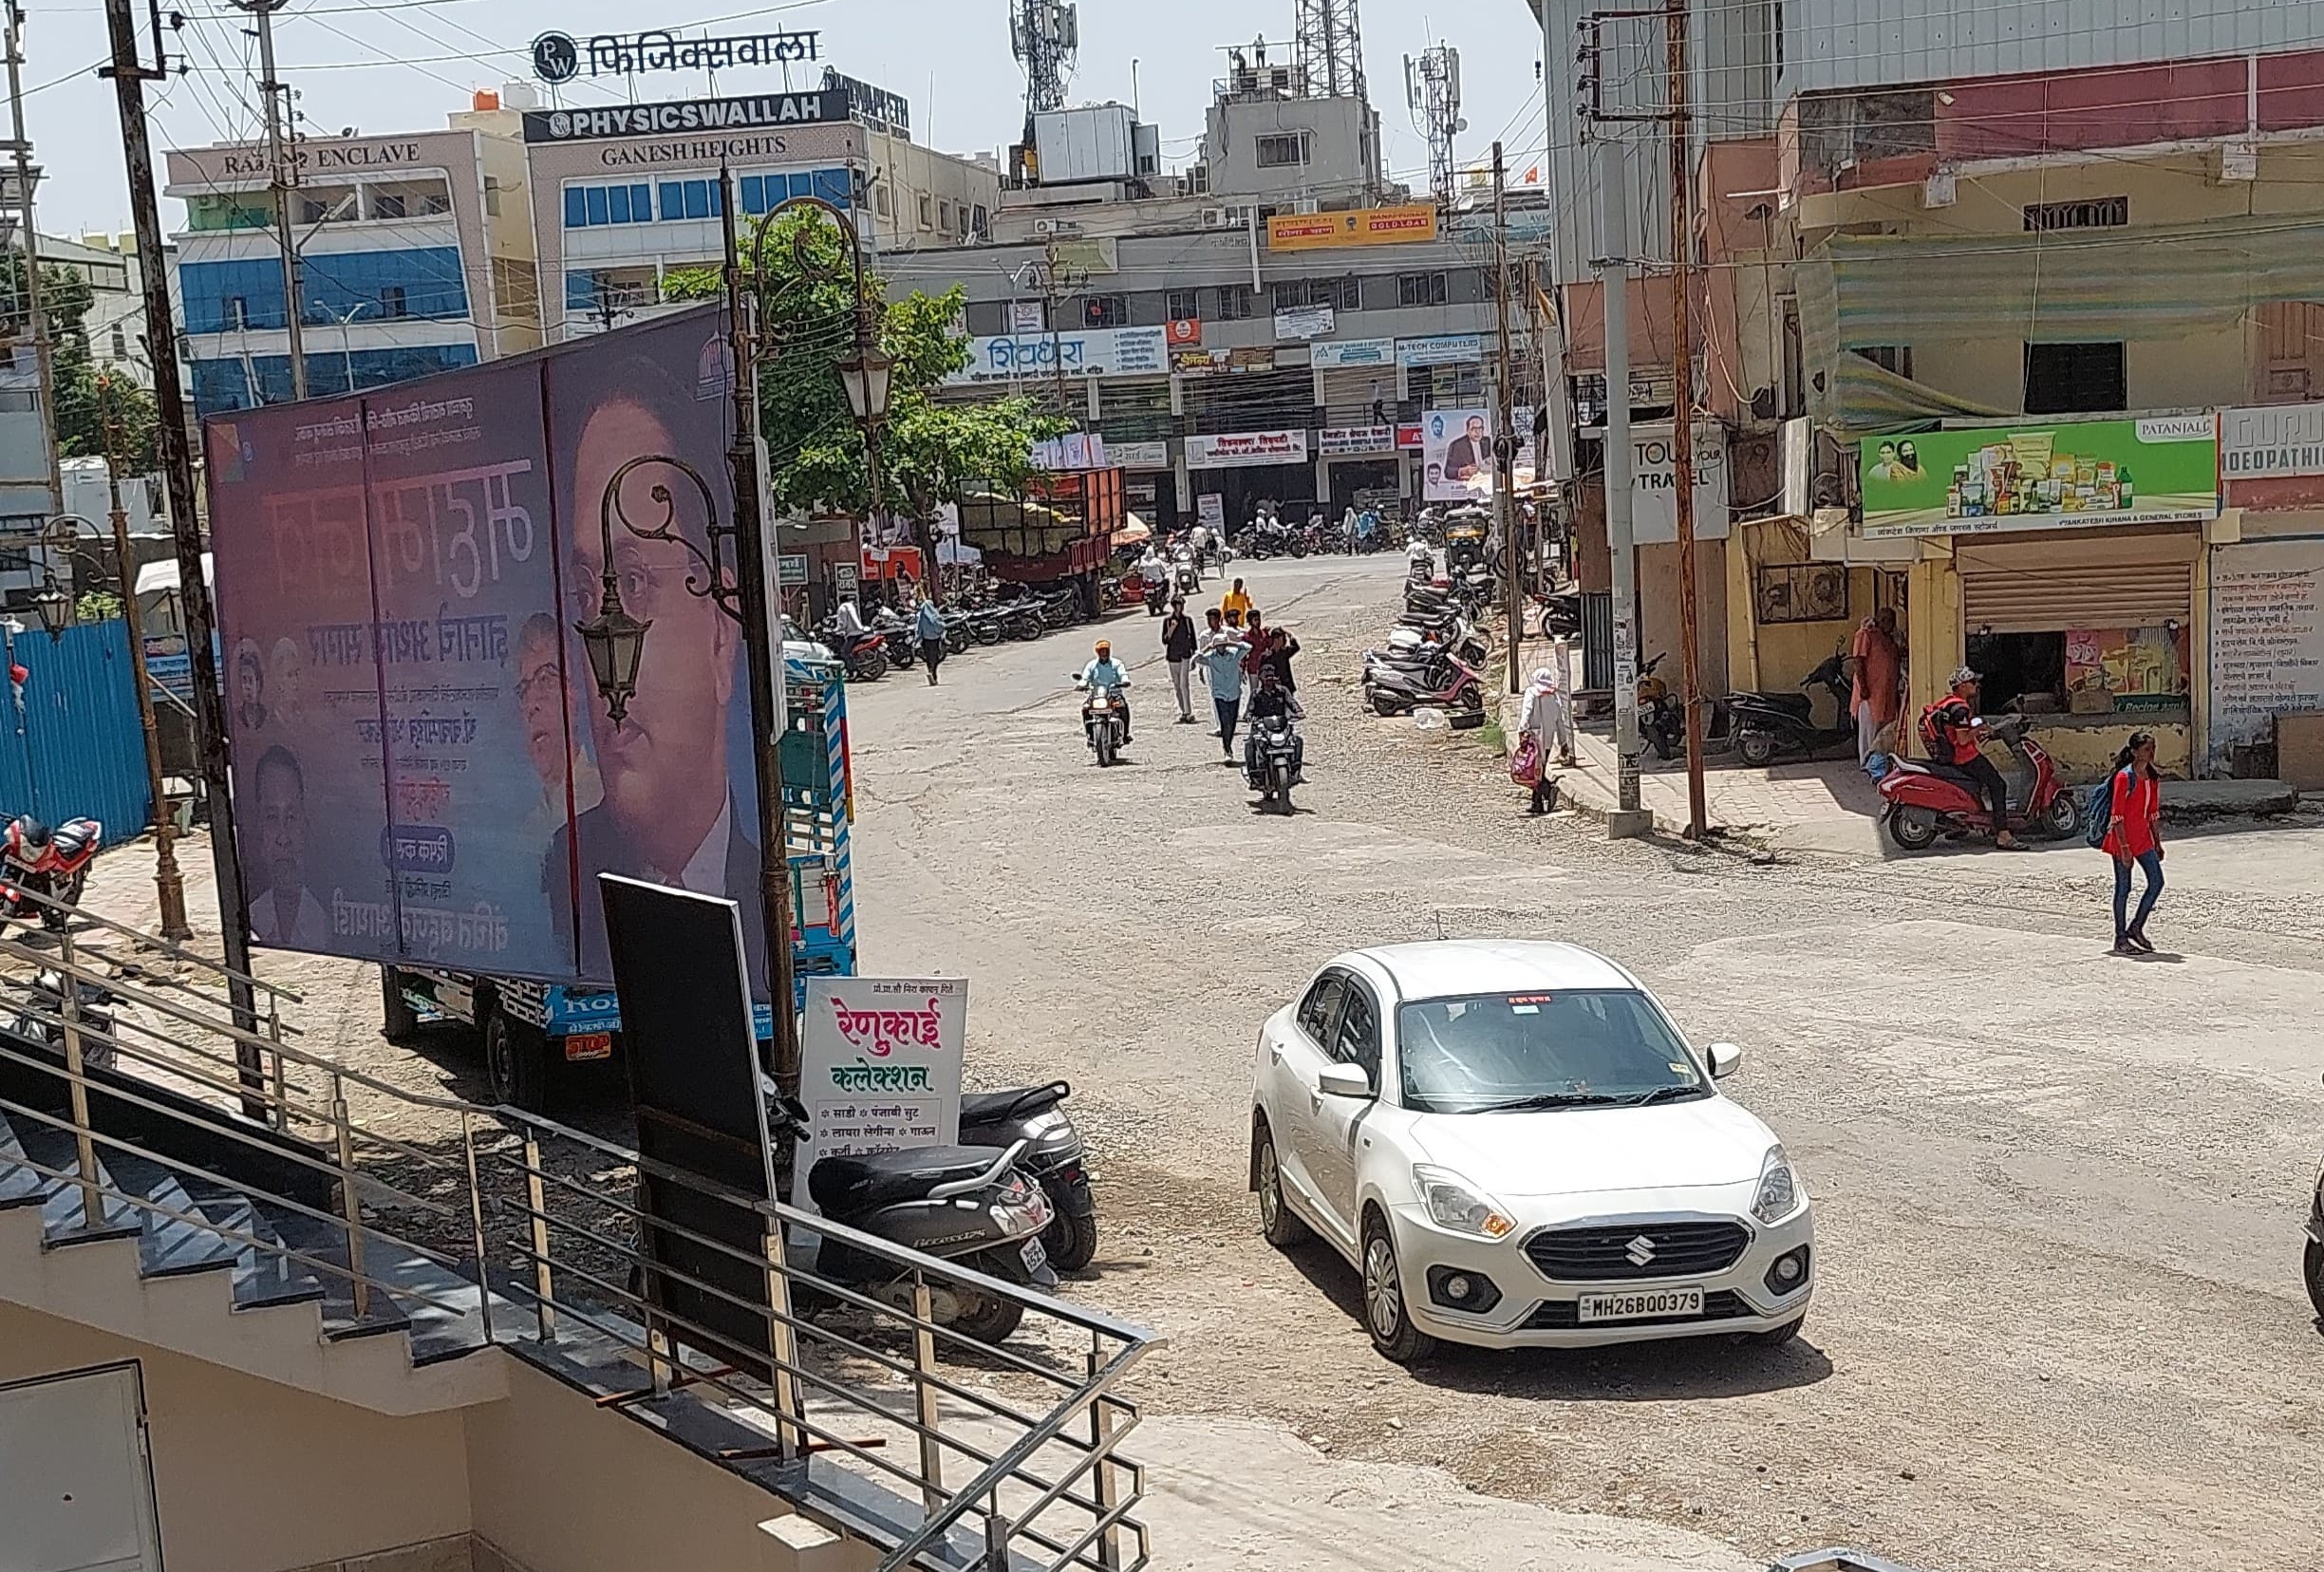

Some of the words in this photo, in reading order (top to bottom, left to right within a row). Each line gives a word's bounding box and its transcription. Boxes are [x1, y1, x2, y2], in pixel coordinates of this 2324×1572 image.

[588, 30, 822, 77] फिजिक्सवाला
[573, 95, 821, 136] PHYSICSWALLAH
[316, 143, 421, 167] ENCLAVE
[601, 144, 686, 166] GANESH
[691, 137, 787, 159] HEIGHTS
[2142, 421, 2211, 436] PATANJALI
[2235, 410, 2324, 448] GURU
[1634, 441, 1691, 466] TOU
[1696, 450, 1721, 461] YOUR
[1639, 469, 1709, 490] TRAEL
[830, 997, 942, 1057] रेणुकाई
[830, 1056, 935, 1093] कलेक्शन
[833, 1105, 855, 1118] साडी
[872, 1104, 901, 1117] पंजाबी
[909, 1126, 935, 1136] गाऊन
[1593, 1293, 1699, 1317] MH26BQ0379
